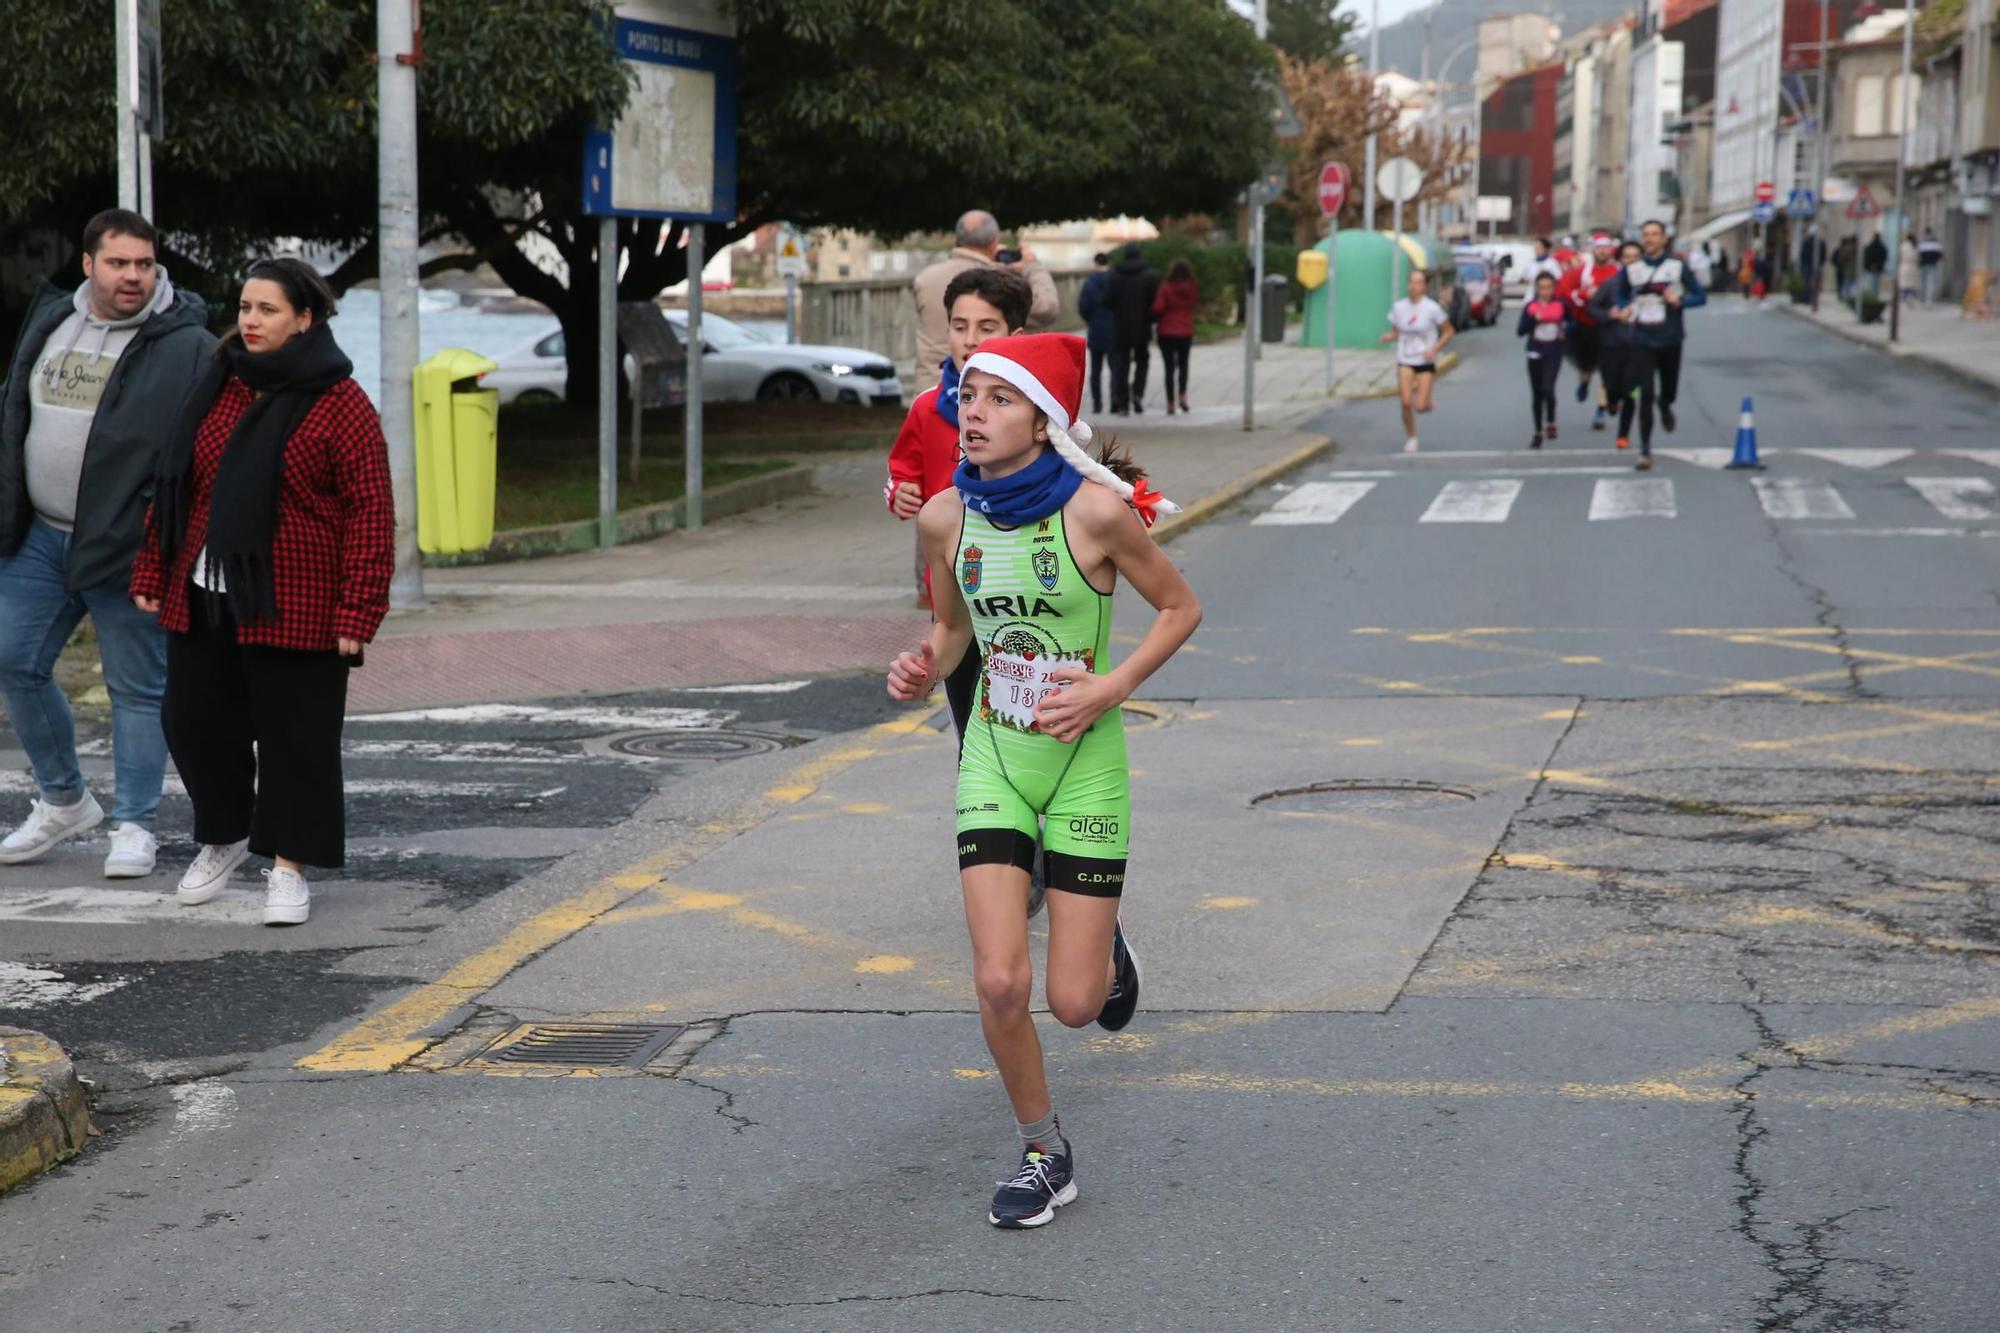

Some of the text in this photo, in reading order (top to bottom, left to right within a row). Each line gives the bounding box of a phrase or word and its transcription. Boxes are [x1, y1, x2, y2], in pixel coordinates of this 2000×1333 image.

[627, 31, 660, 52] PORTO
[662, 36, 674, 55] DE
[67, 364, 106, 390] Jean
[973, 595, 1064, 618] IRIA
